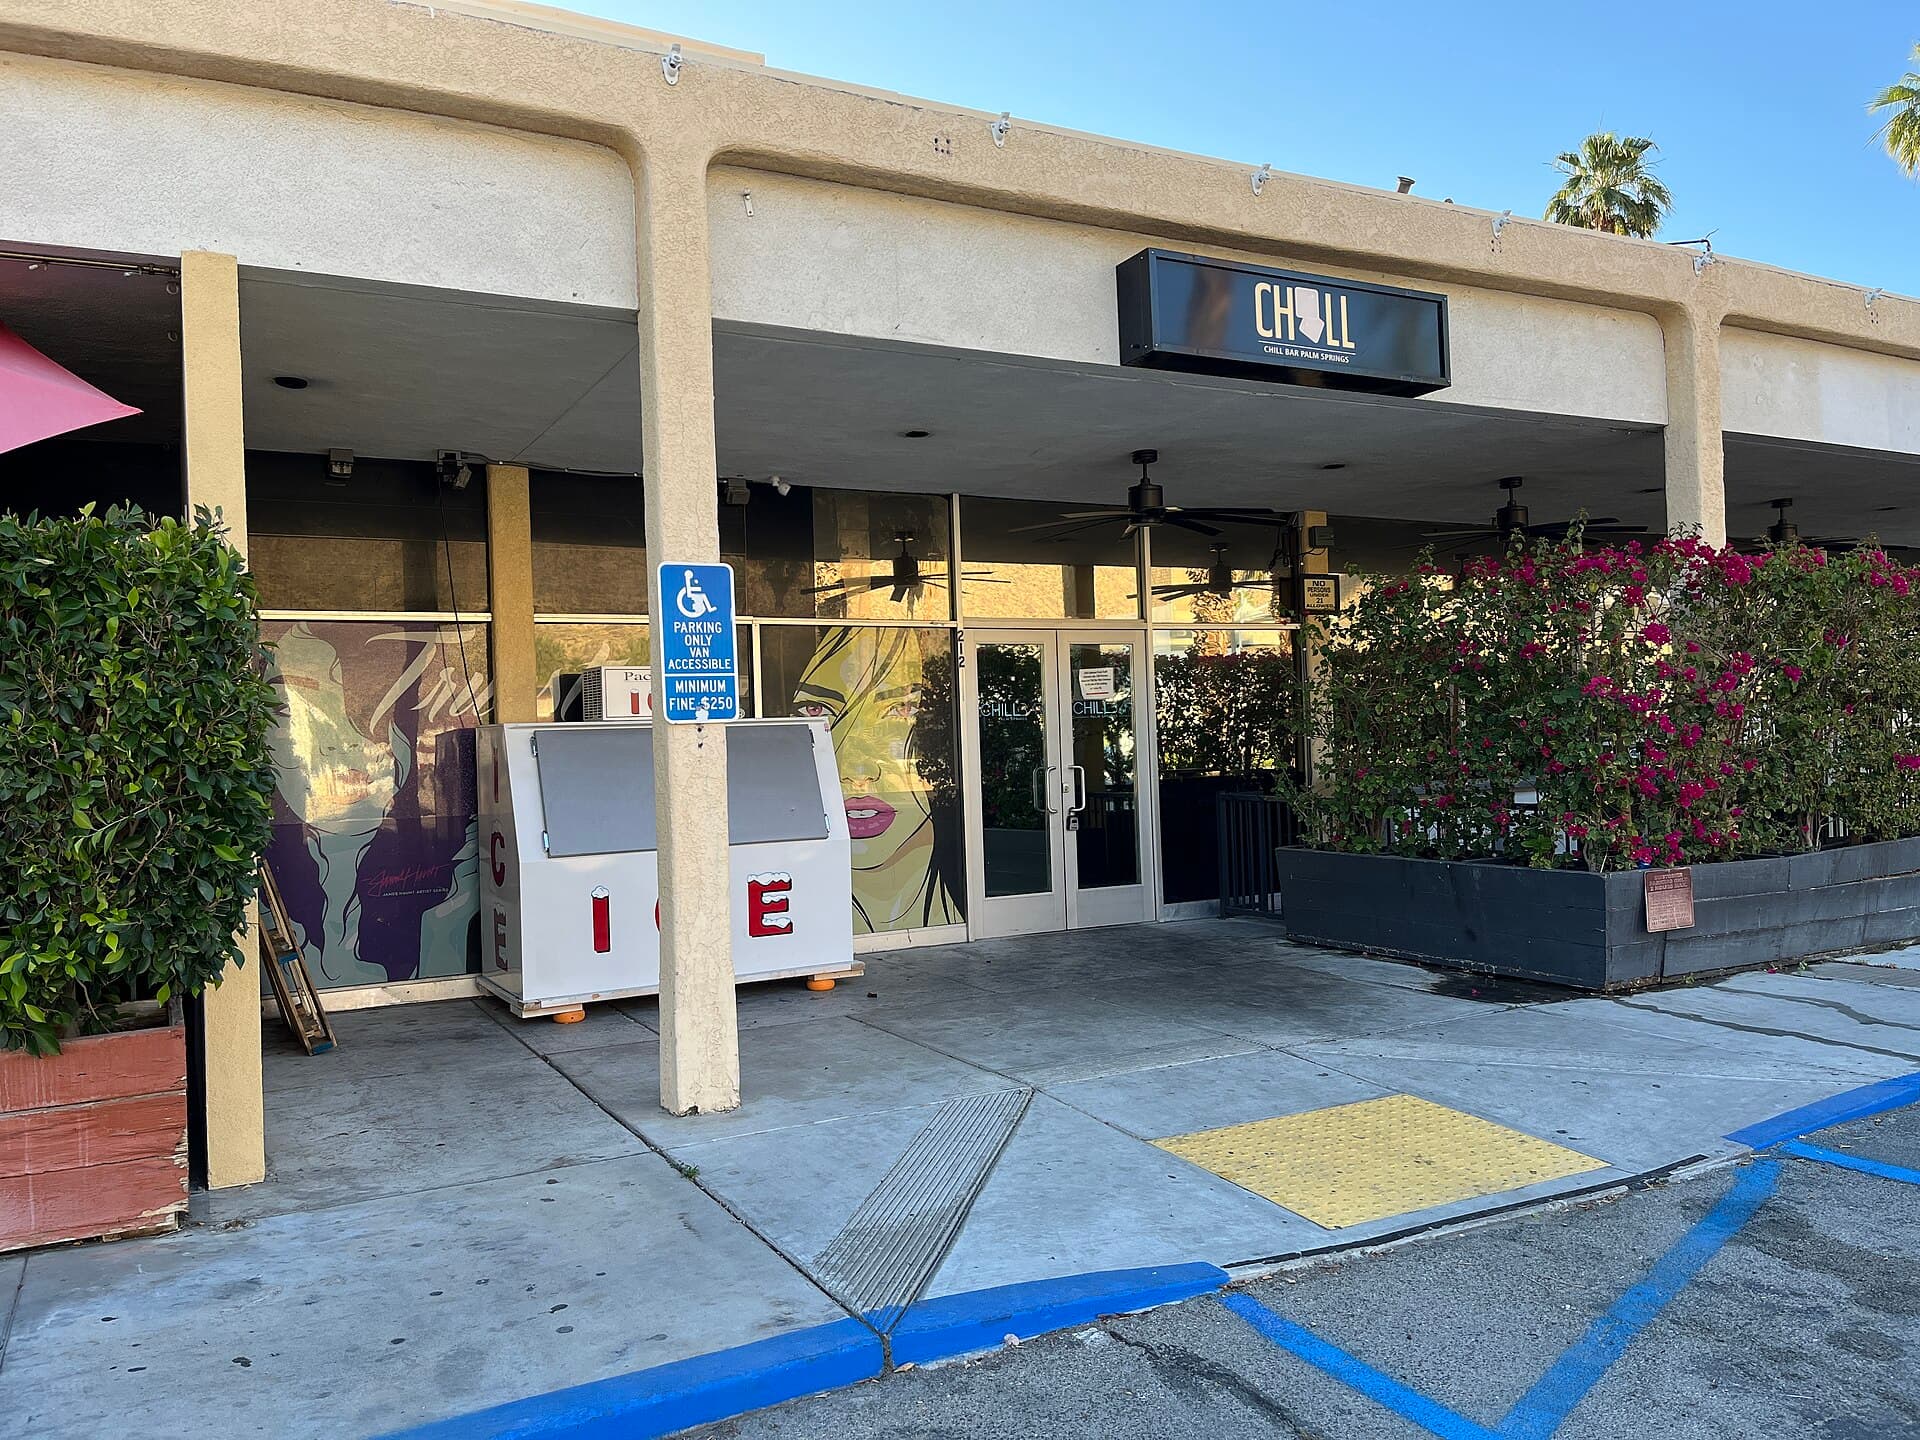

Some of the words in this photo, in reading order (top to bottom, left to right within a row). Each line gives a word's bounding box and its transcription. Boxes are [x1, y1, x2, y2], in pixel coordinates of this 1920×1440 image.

[1263, 345, 1284, 355] CHILL
[1285, 348, 1300, 357] BAR
[1300, 350, 1320, 360] PALM
[1320, 353, 1350, 364] SPRINGS
[674, 621, 722, 634] PARKING
[684, 634, 713, 647] ONLY
[689, 646, 710, 658] VAN
[668, 658, 732, 670] ACCESSIBLE
[624, 671, 652, 681] Pac
[675, 679, 727, 693] MINIMUM
[669, 697, 696, 711] FINE
[700, 695, 733, 711] $250
[980, 702, 1026, 717] CHILL
[1073, 701, 1117, 715] CHILL
[490, 745, 509, 973] ICE
[590, 871, 794, 954] IE
